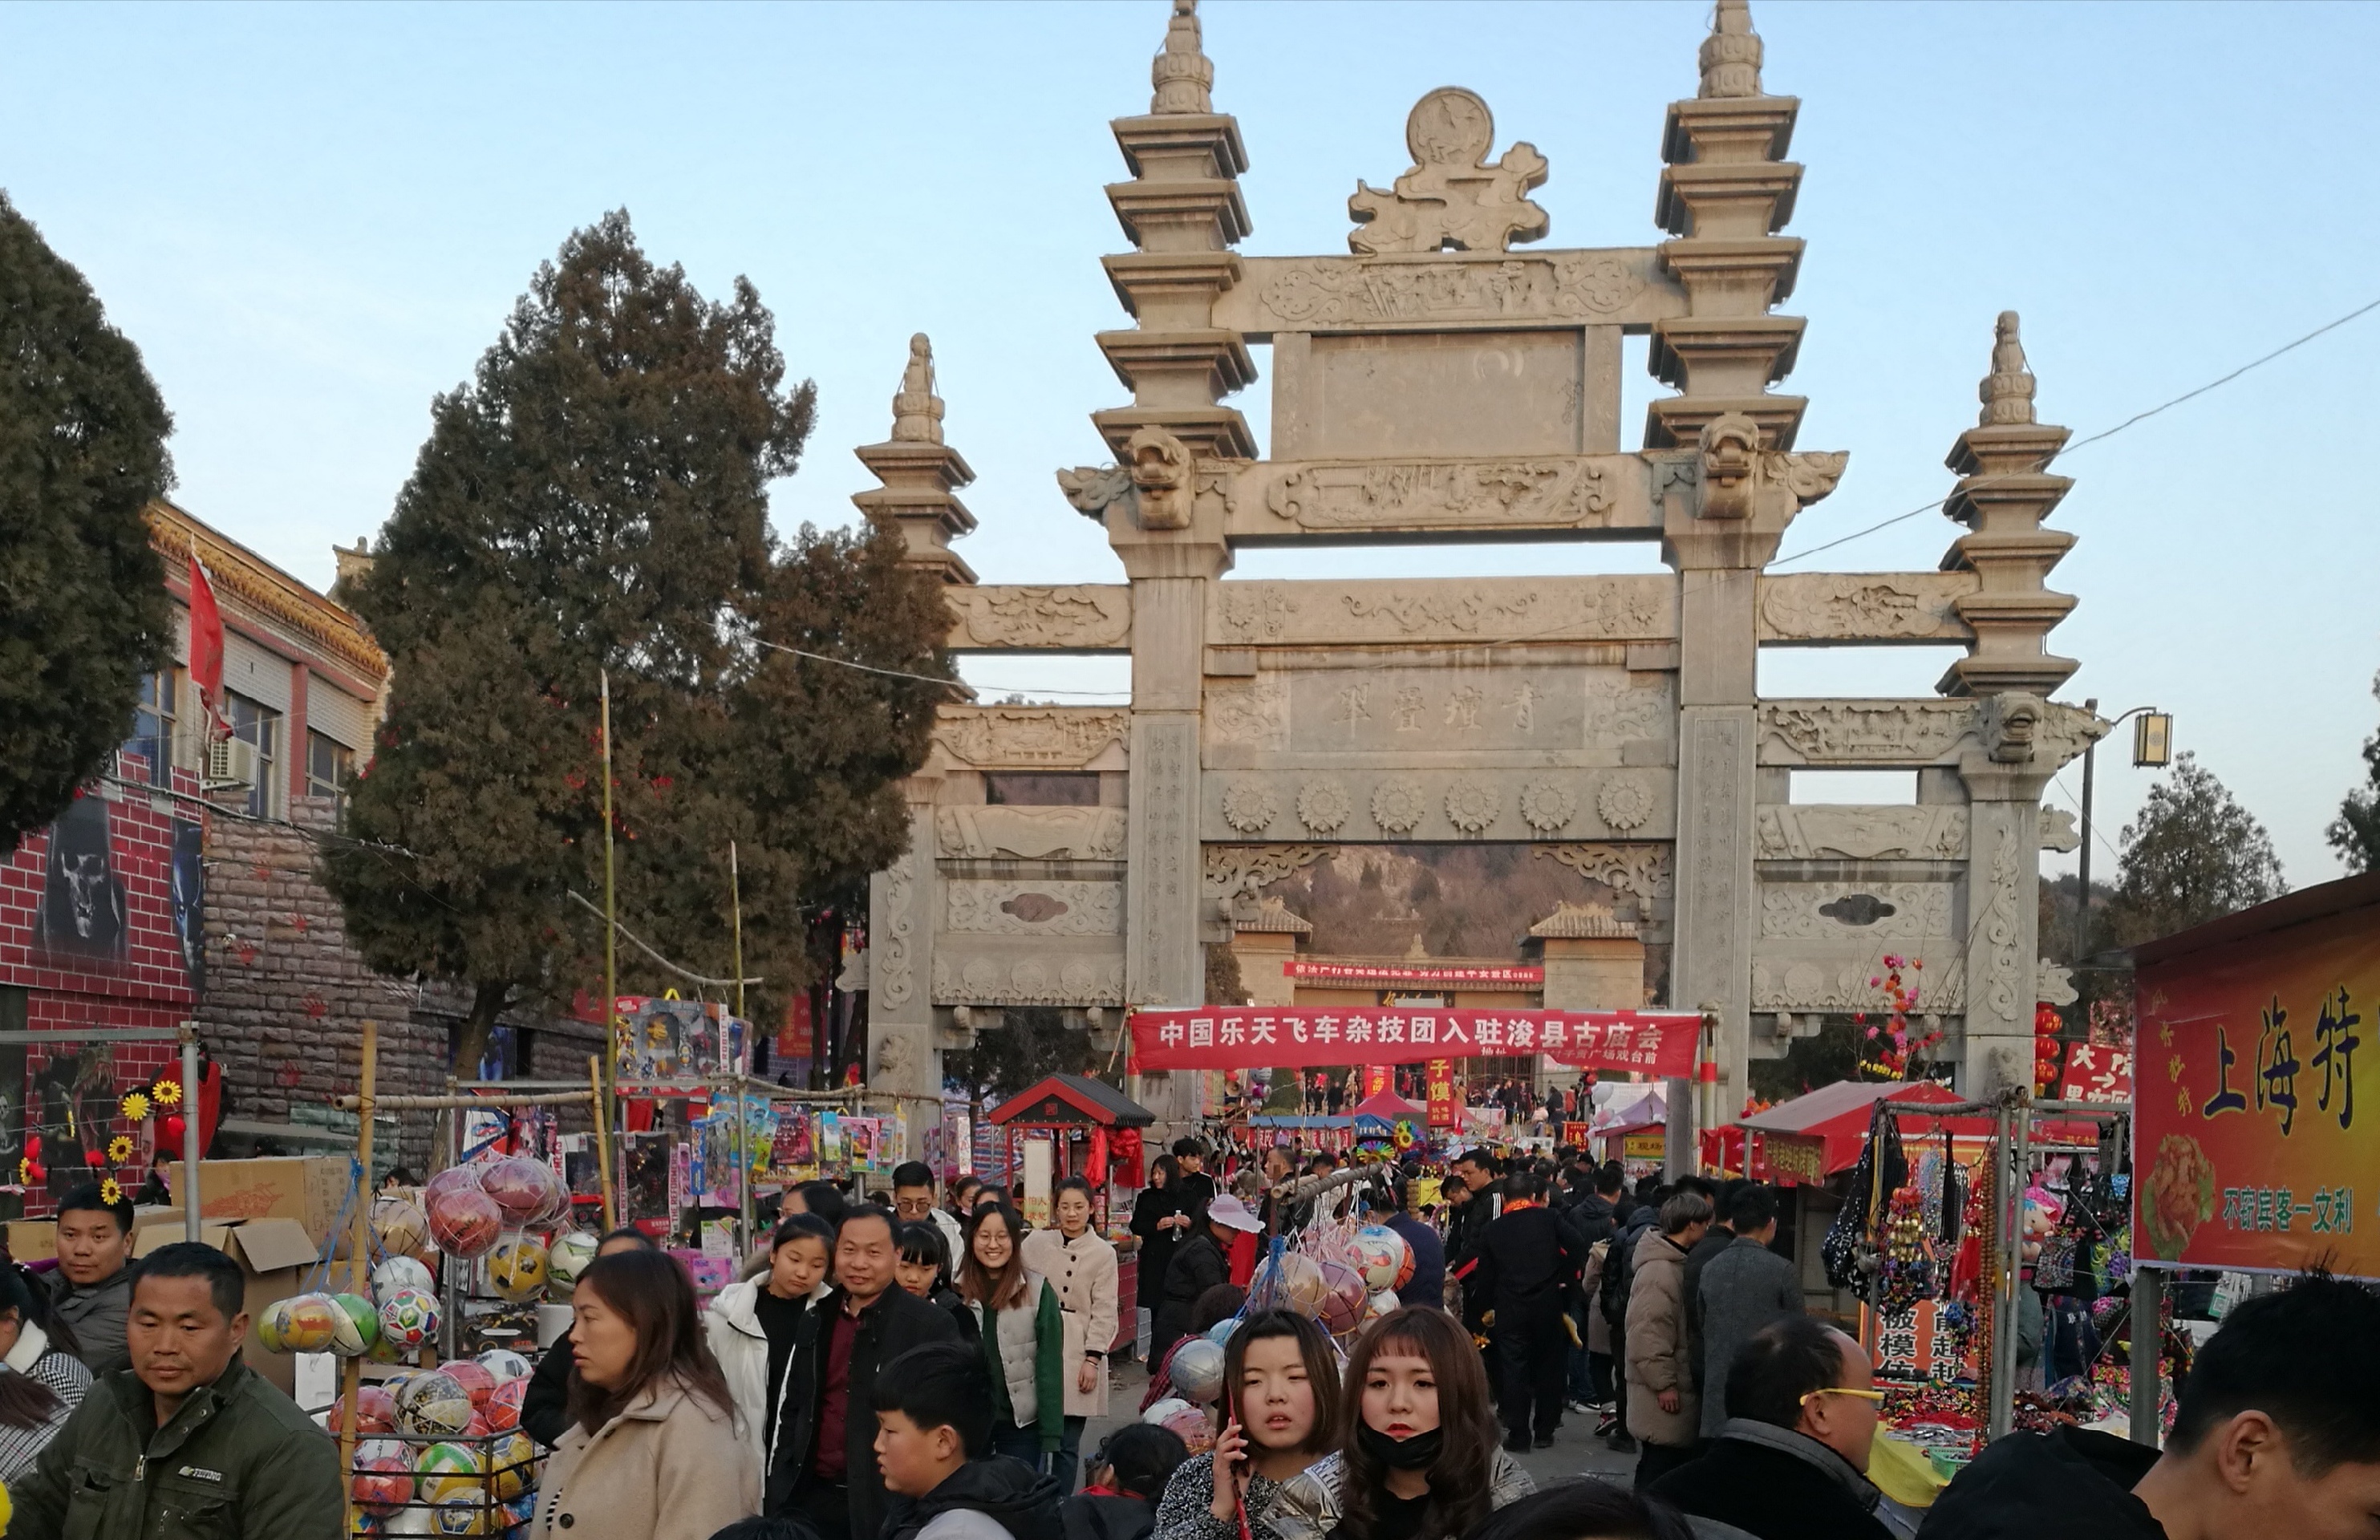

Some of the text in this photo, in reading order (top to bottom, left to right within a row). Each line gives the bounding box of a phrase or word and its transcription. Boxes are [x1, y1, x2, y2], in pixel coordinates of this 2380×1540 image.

[1160, 1015, 1664, 1050] 中国乐天飞车杂技团入驻浚县古庙会
[2203, 980, 2380, 1137] 上海特
[671, 1153, 679, 1205] REFORMERS
